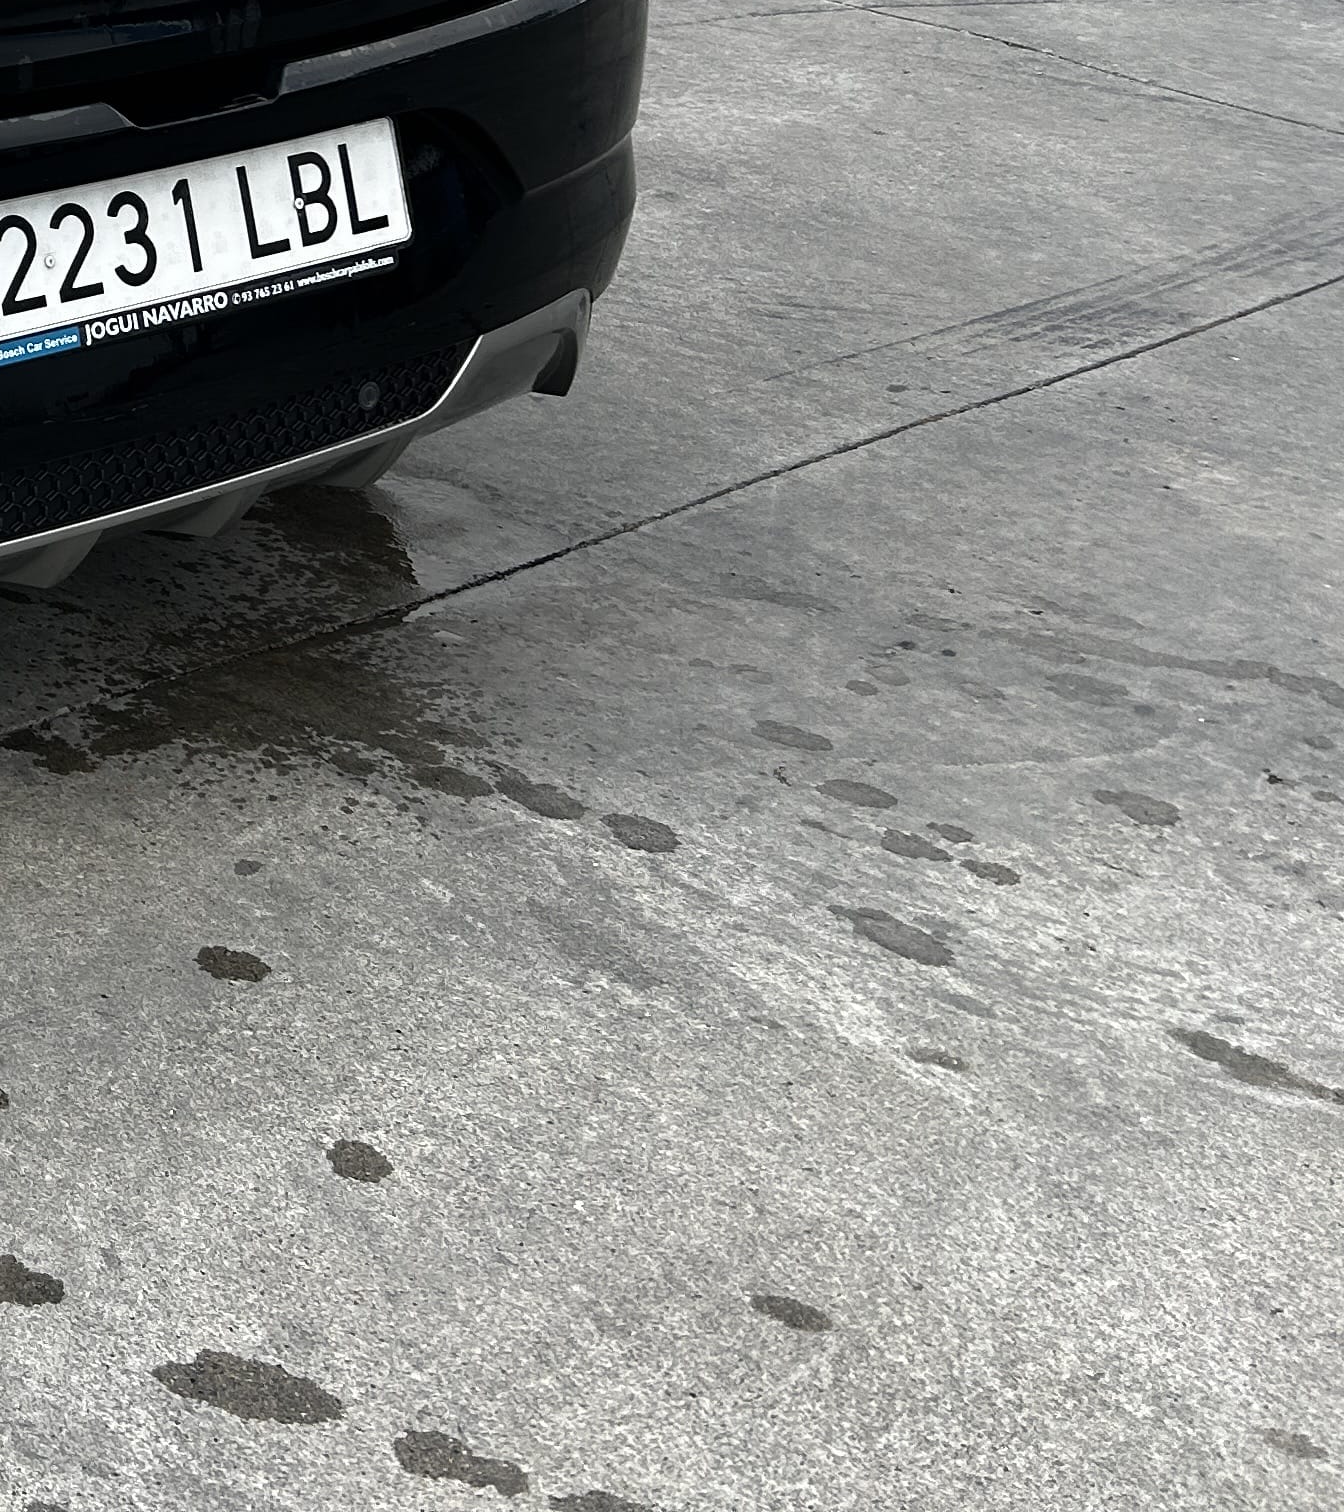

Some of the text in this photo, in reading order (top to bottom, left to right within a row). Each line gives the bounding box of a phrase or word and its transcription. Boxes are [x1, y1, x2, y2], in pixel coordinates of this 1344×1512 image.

[236, 143, 390, 260] LBL
[26, 342, 43, 354] Car
[44, 334, 78, 349] Service
[85, 312, 140, 347] JOGUI
[142, 292, 229, 328] NAVARRO
[241, 291, 253, 302] 93
[271, 285, 283, 295] 23
[283, 282, 295, 293] 61
